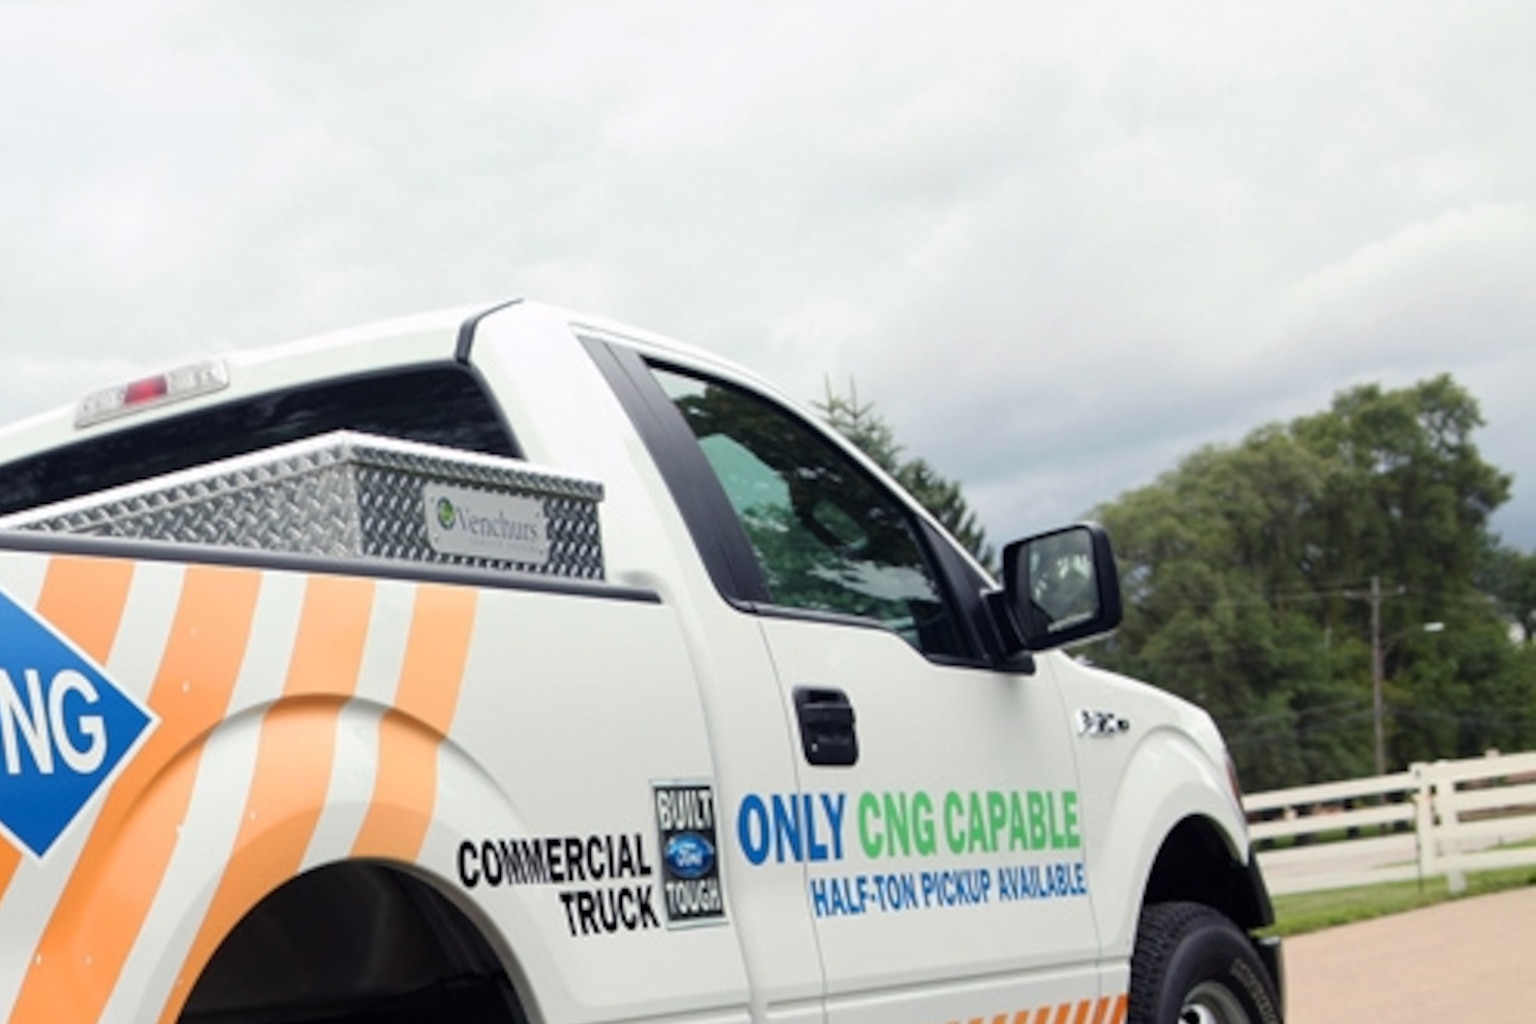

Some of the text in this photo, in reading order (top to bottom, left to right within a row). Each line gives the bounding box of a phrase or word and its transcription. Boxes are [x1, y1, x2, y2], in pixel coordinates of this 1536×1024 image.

[656, 788, 715, 830] BUILT
[736, 790, 1081, 866] ONLY CNG CAPABLE
[457, 833, 652, 888] COMMERCIAL
[560, 885, 661, 938] TRUCK
[666, 879, 721, 914] TOUGH
[809, 862, 1088, 918] HALF-TON PICKUP AVAILABLE
